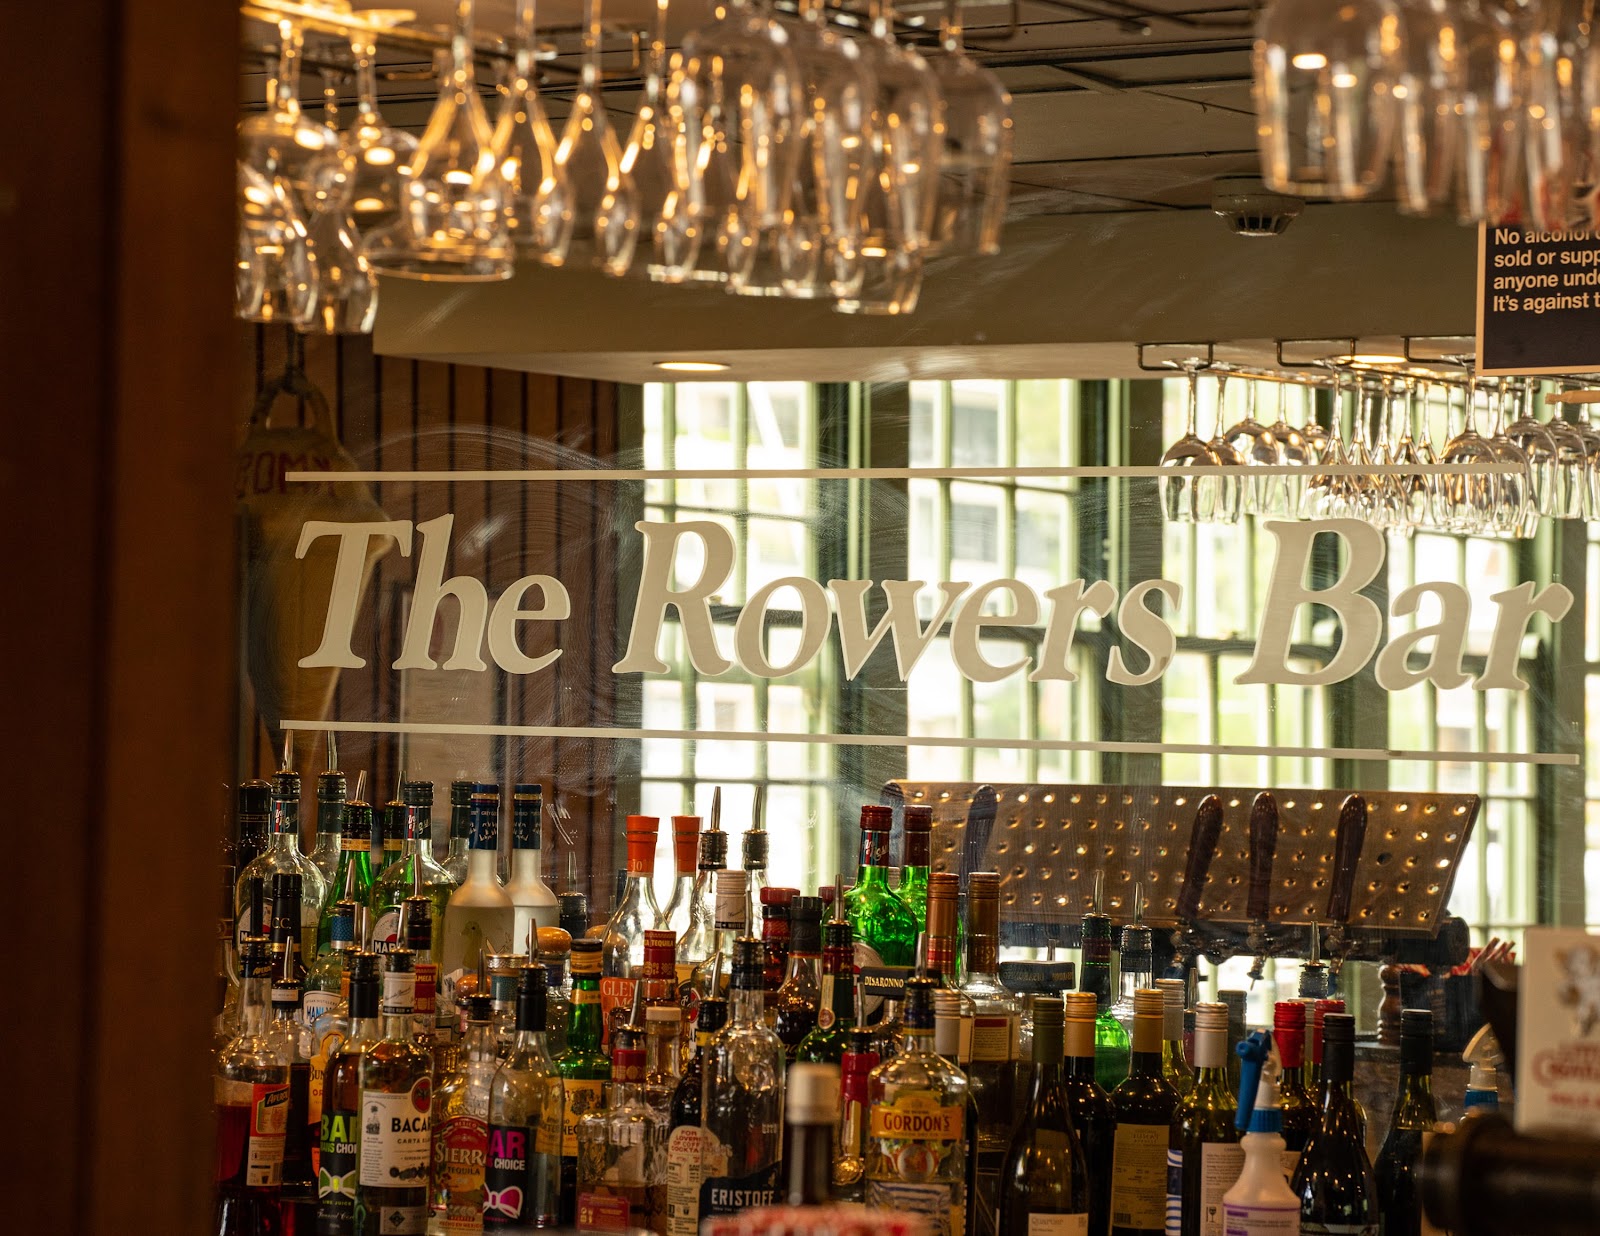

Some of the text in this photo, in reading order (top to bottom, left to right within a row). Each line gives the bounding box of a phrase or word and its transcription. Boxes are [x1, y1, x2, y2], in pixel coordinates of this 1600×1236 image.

[1494, 228, 1520, 245] No
[1494, 250, 1532, 268] sold
[1536, 251, 1556, 266] or
[1493, 268, 1600, 292] anyone und
[1523, 293, 1590, 314] against
[295, 513, 1575, 691] The Rowers Bar
[652, 939, 674, 947] TEQUILA
[864, 975, 904, 989] DISARONNO
[447, 1166, 480, 1176] TEQUILA
[494, 1157, 526, 1171] CHOICE
[711, 1188, 775, 1207] ERISTOFF
